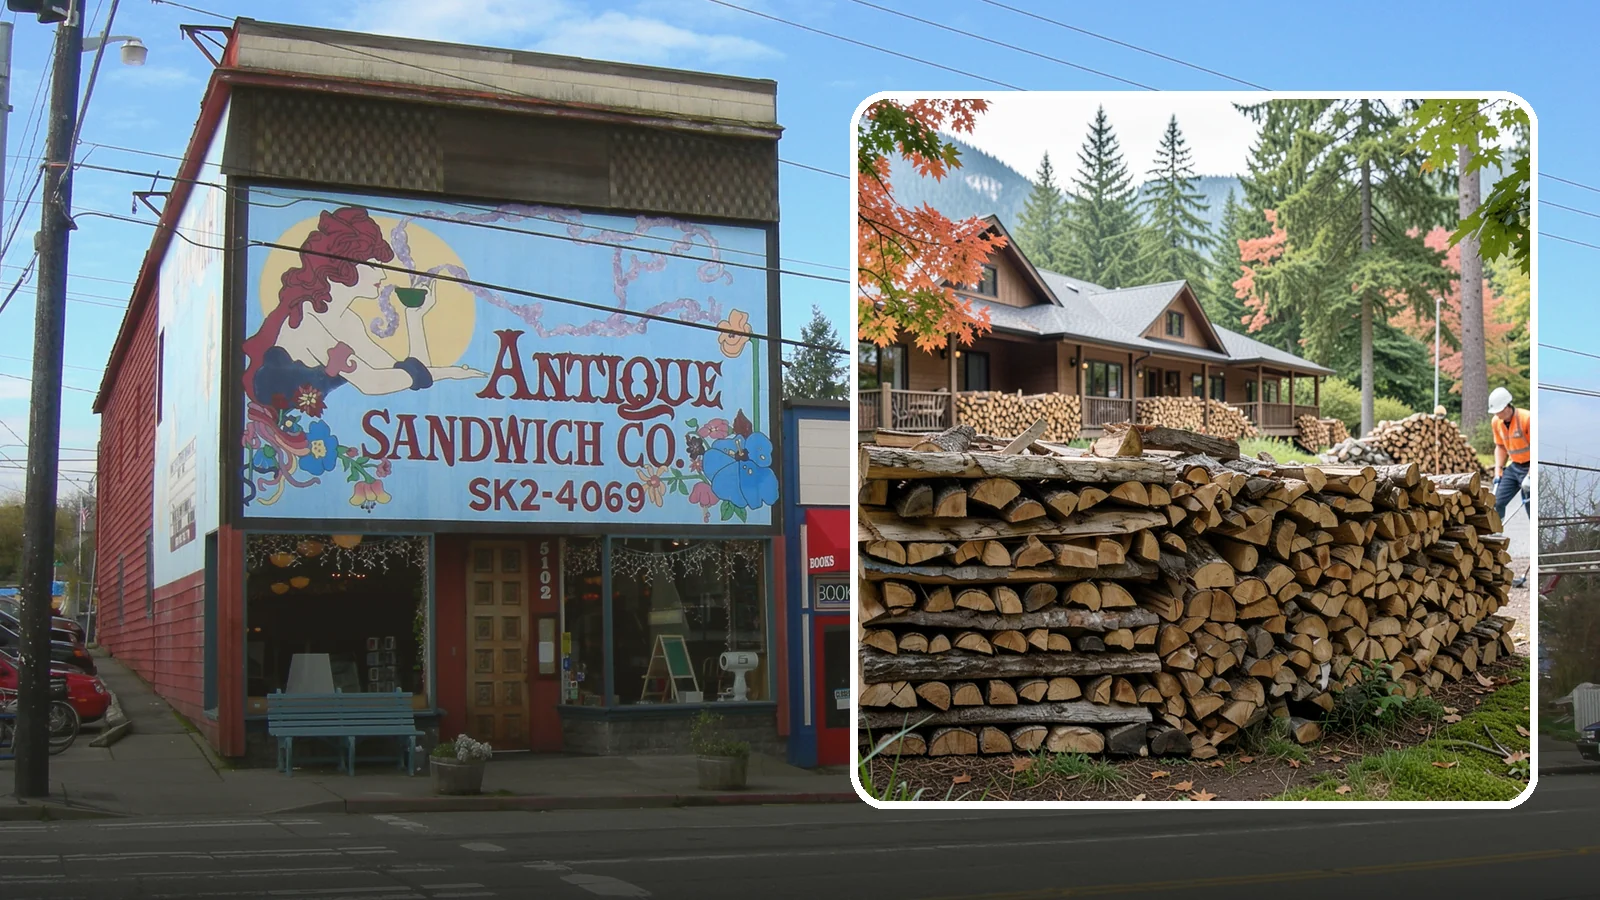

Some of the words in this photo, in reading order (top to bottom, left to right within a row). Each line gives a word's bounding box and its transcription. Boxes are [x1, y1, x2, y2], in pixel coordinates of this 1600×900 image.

[475, 329, 723, 420] ANTIQUE
[361, 408, 604, 467] SANDWICH
[617, 422, 685, 469] CO.
[468, 477, 645, 513] SK2-4069
[540, 541, 551, 599] 5102
[809, 555, 835, 569] BOOKS
